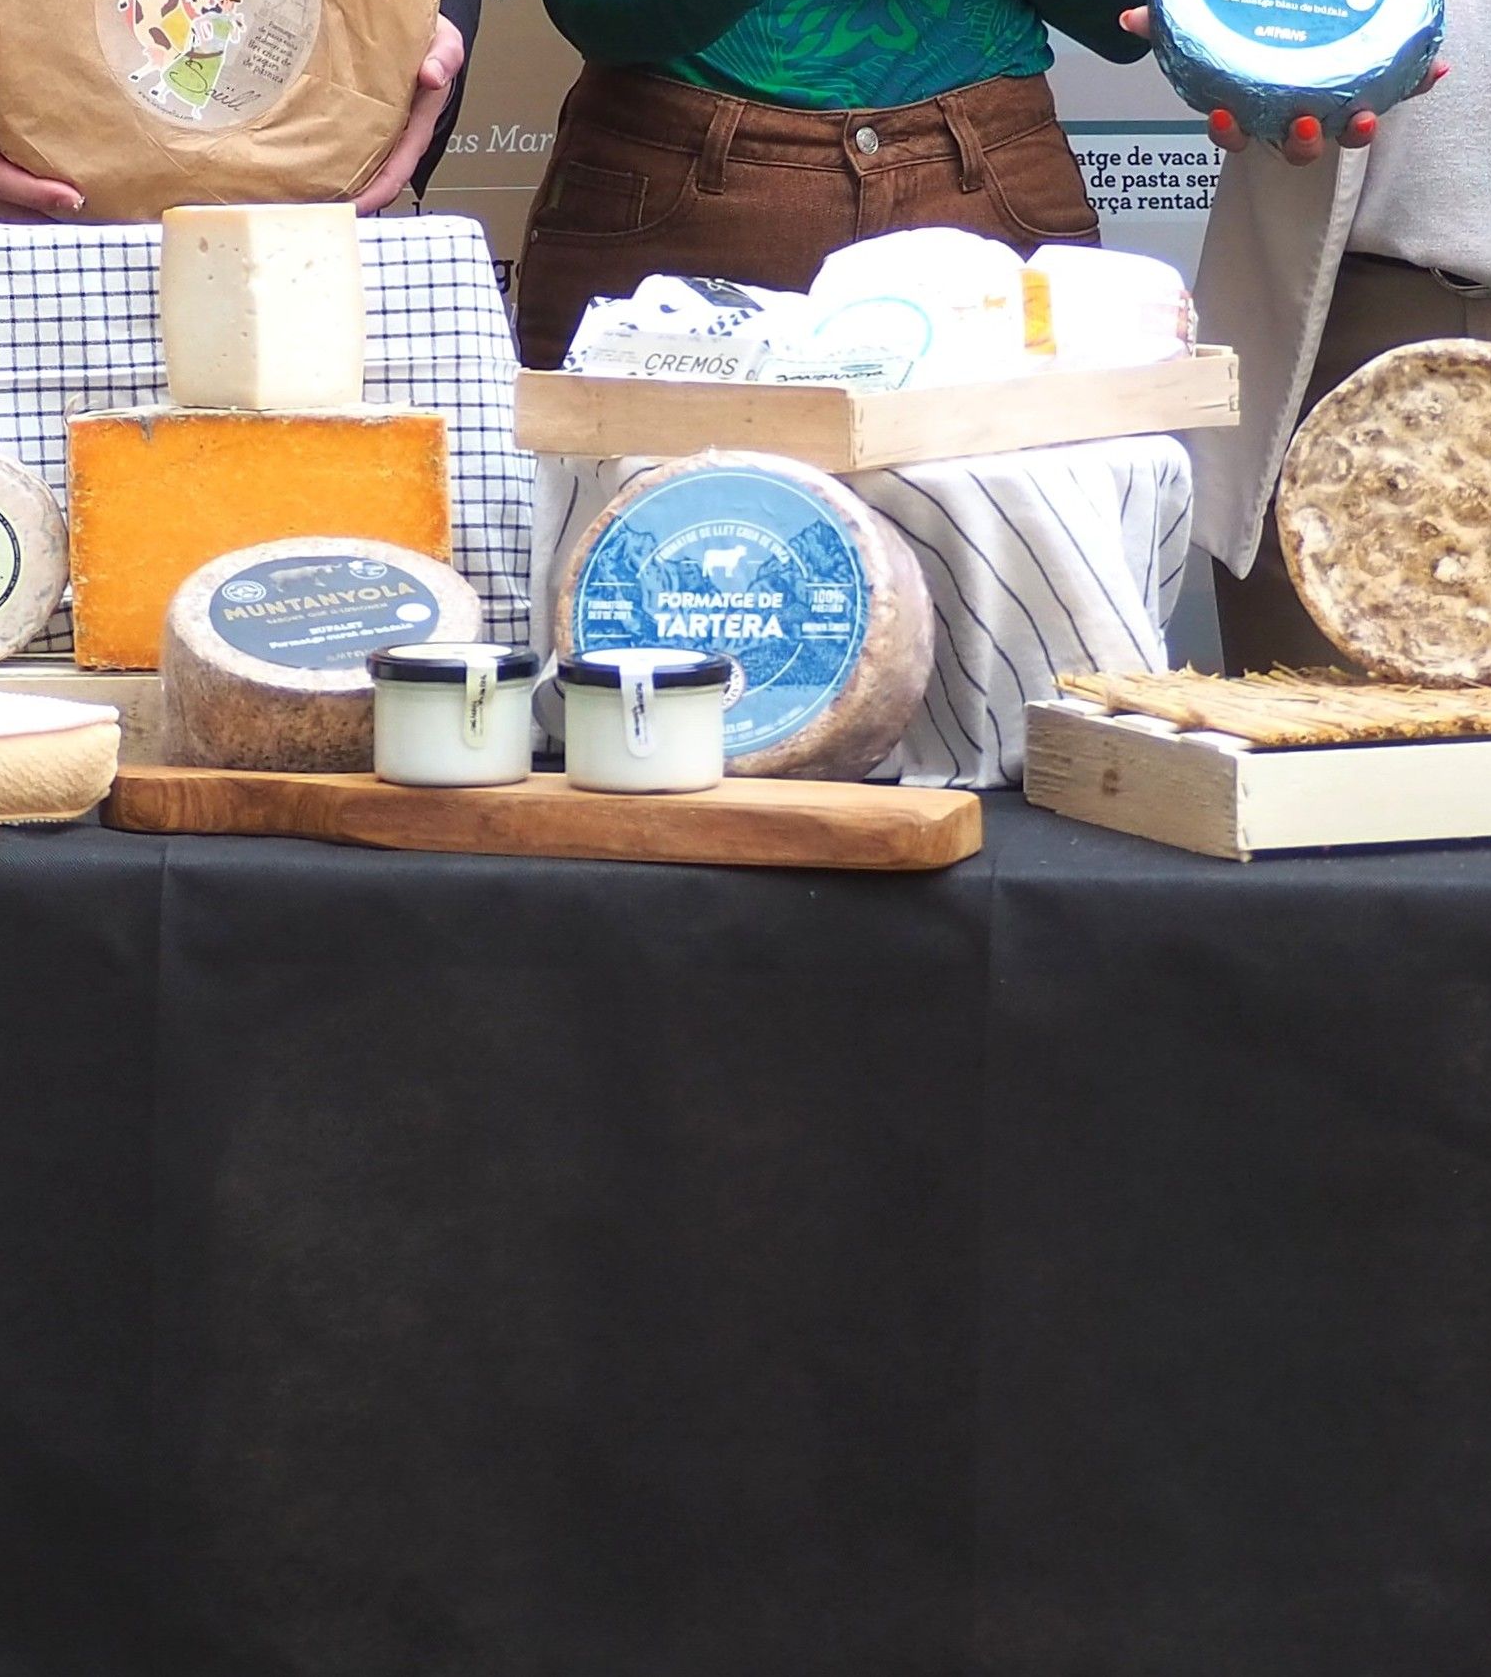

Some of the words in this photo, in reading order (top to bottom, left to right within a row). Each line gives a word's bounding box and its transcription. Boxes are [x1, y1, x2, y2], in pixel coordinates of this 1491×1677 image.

[1127, 146, 1152, 166] de
[1158, 151, 1208, 166] vaca
[1090, 171, 1116, 188] de
[1122, 173, 1181, 192] pasta
[1137, 190, 1214, 210] rentad
[643, 353, 740, 375] CREMÓS
[222, 581, 416, 621] MUNTANYOLA
[657, 592, 755, 609] FORMATGE
[757, 592, 784, 609] DE
[653, 614, 785, 639] TARTERA
